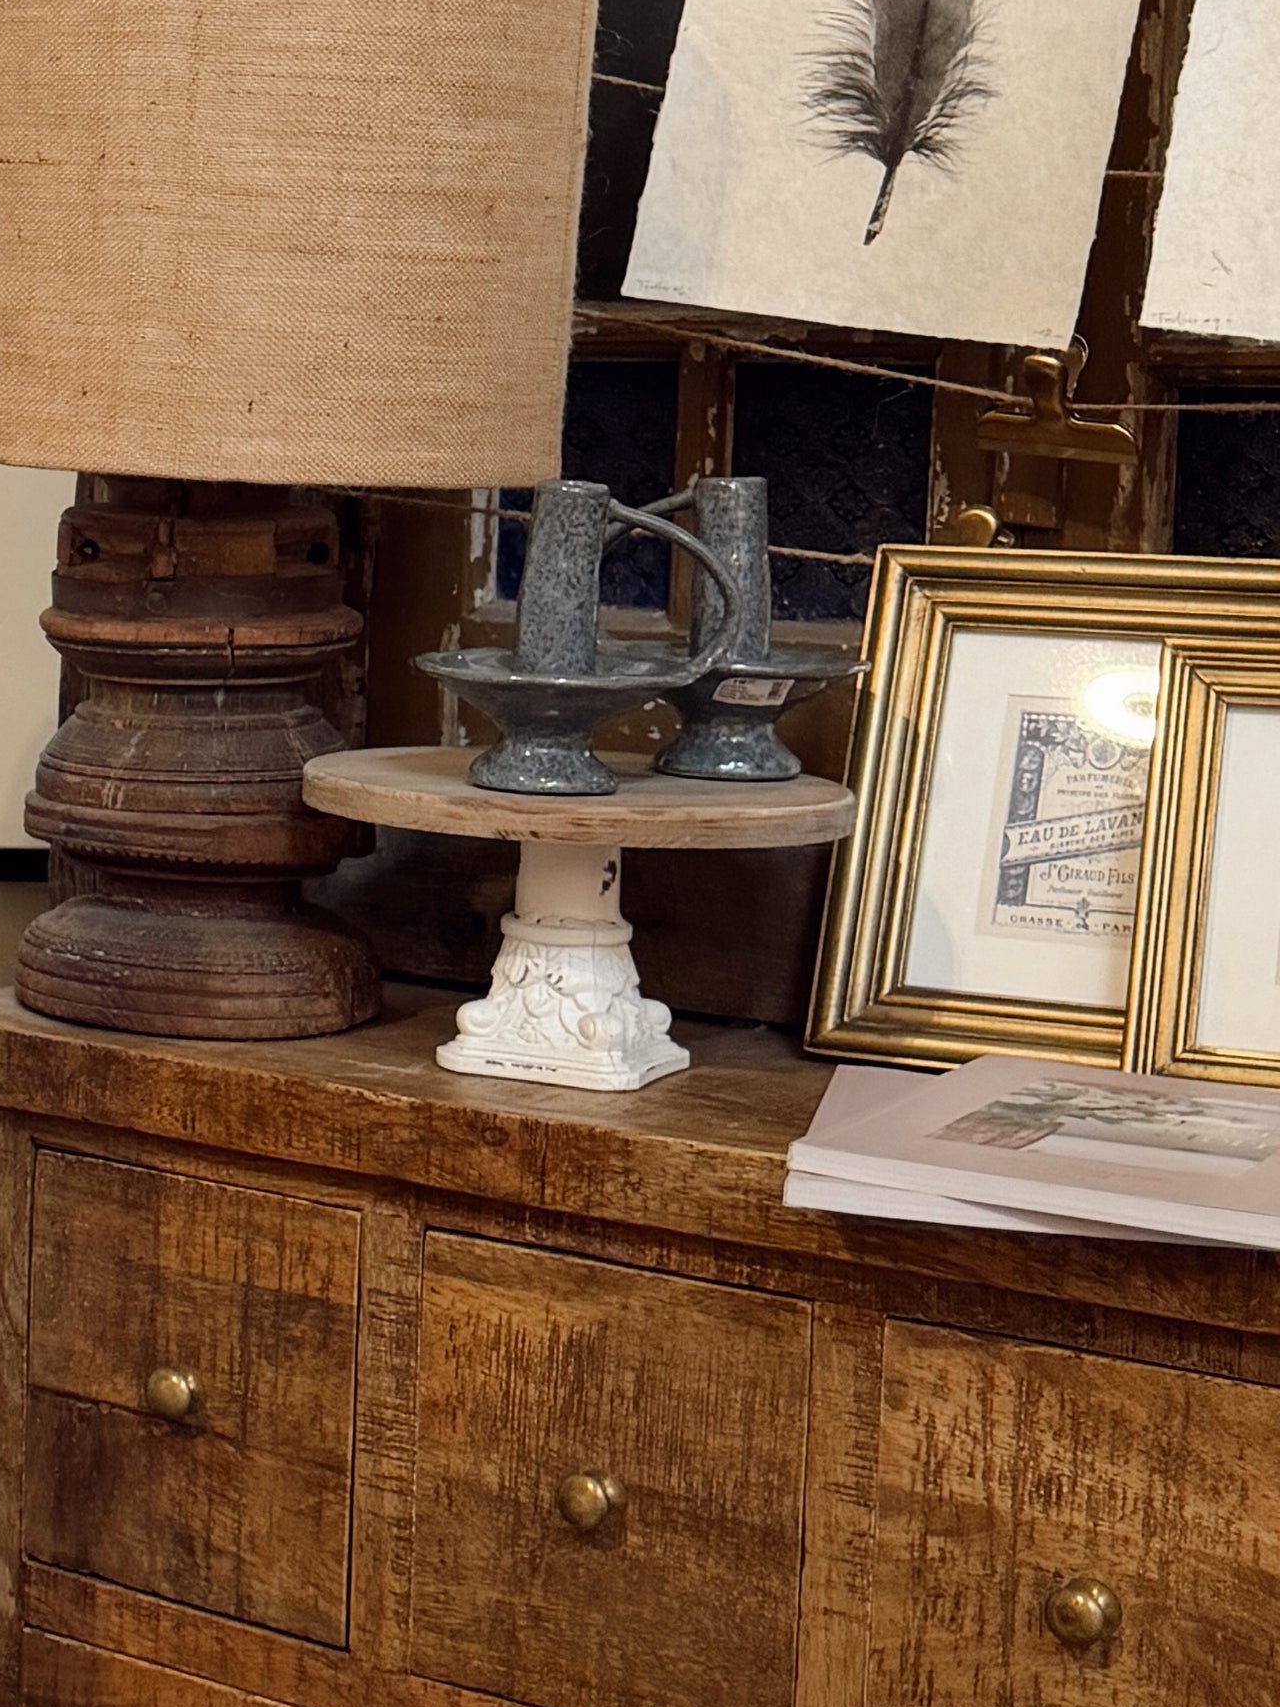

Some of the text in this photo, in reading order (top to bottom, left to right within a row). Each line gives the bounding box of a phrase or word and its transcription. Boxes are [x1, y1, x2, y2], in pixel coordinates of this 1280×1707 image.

[1018, 811, 1143, 846] EAU DE LAVAN
[1107, 867, 1137, 887] FILS
[1102, 921, 1133, 933] PAR
